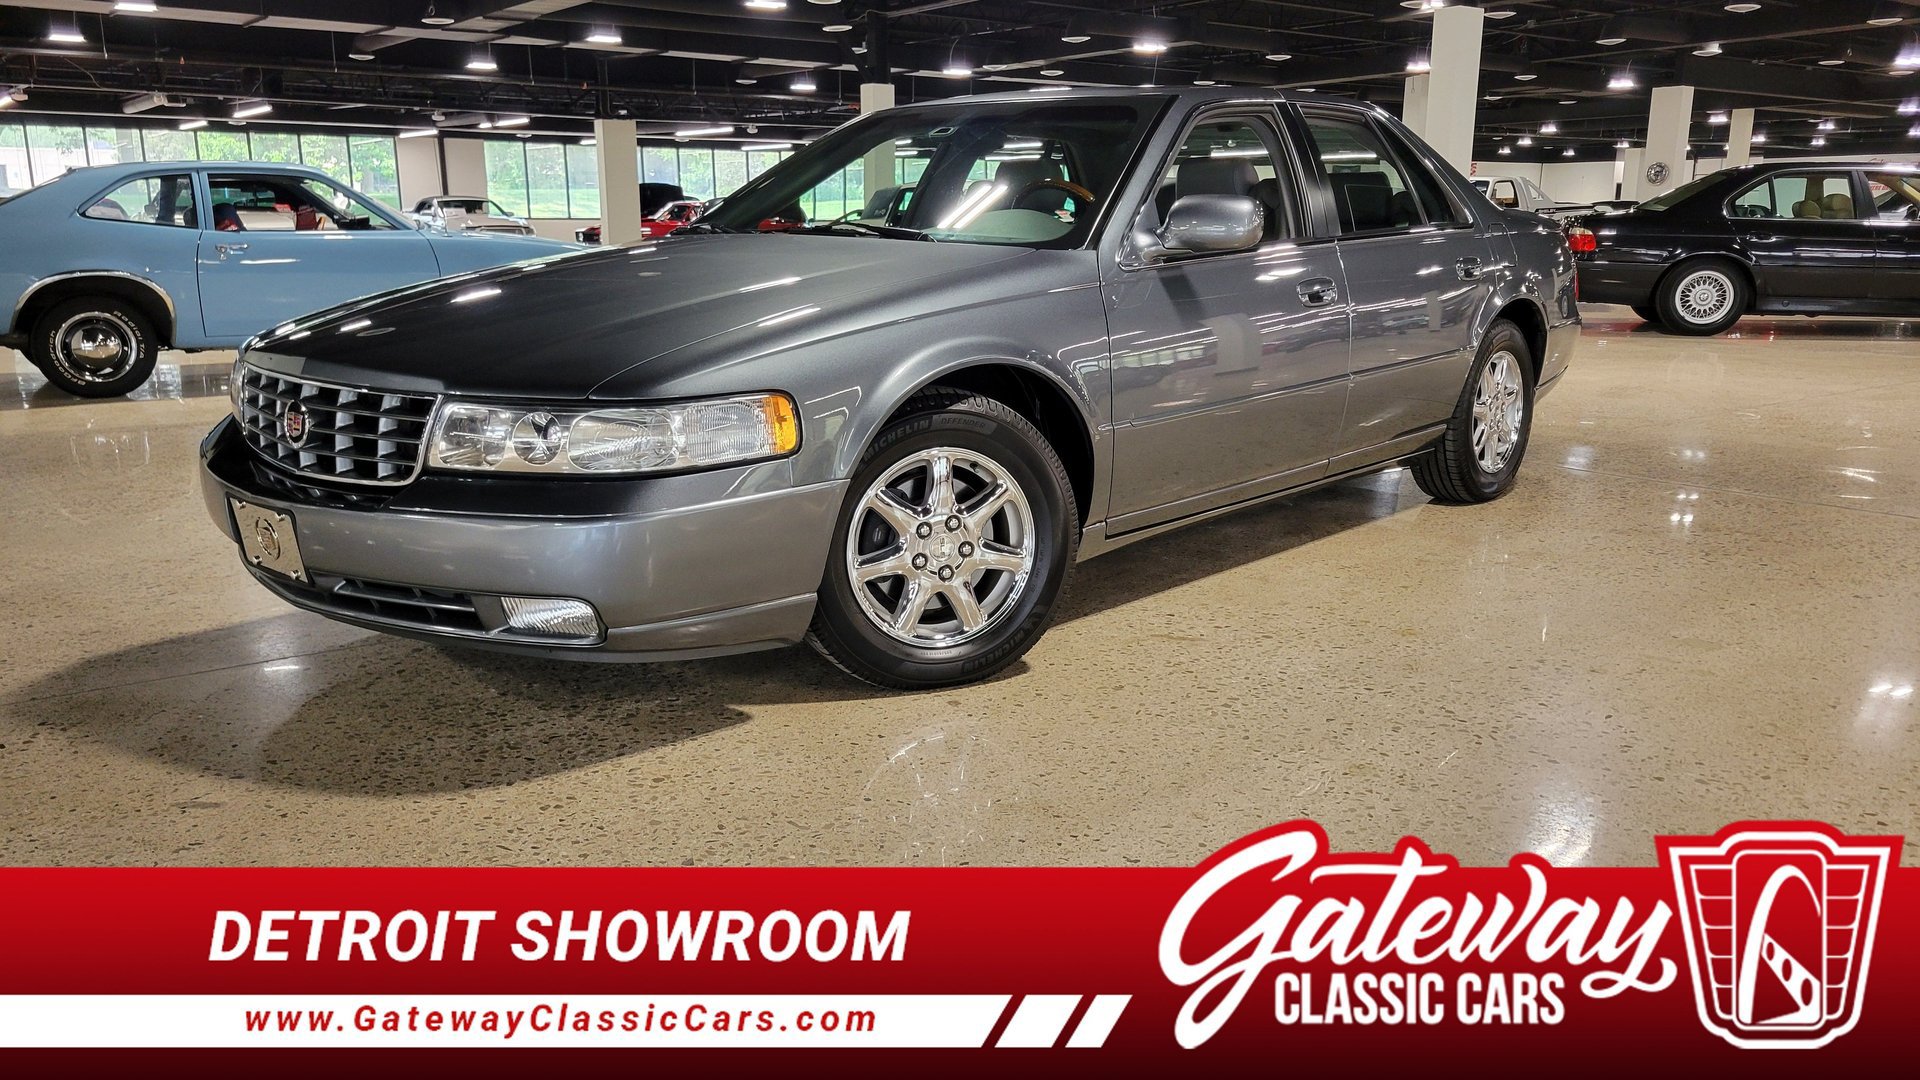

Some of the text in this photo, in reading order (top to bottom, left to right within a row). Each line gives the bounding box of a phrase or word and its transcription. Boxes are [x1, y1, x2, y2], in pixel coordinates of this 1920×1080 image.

[113, 310, 143, 341] Radial
[862, 417, 986, 463] MICHELIN DEFENDER
